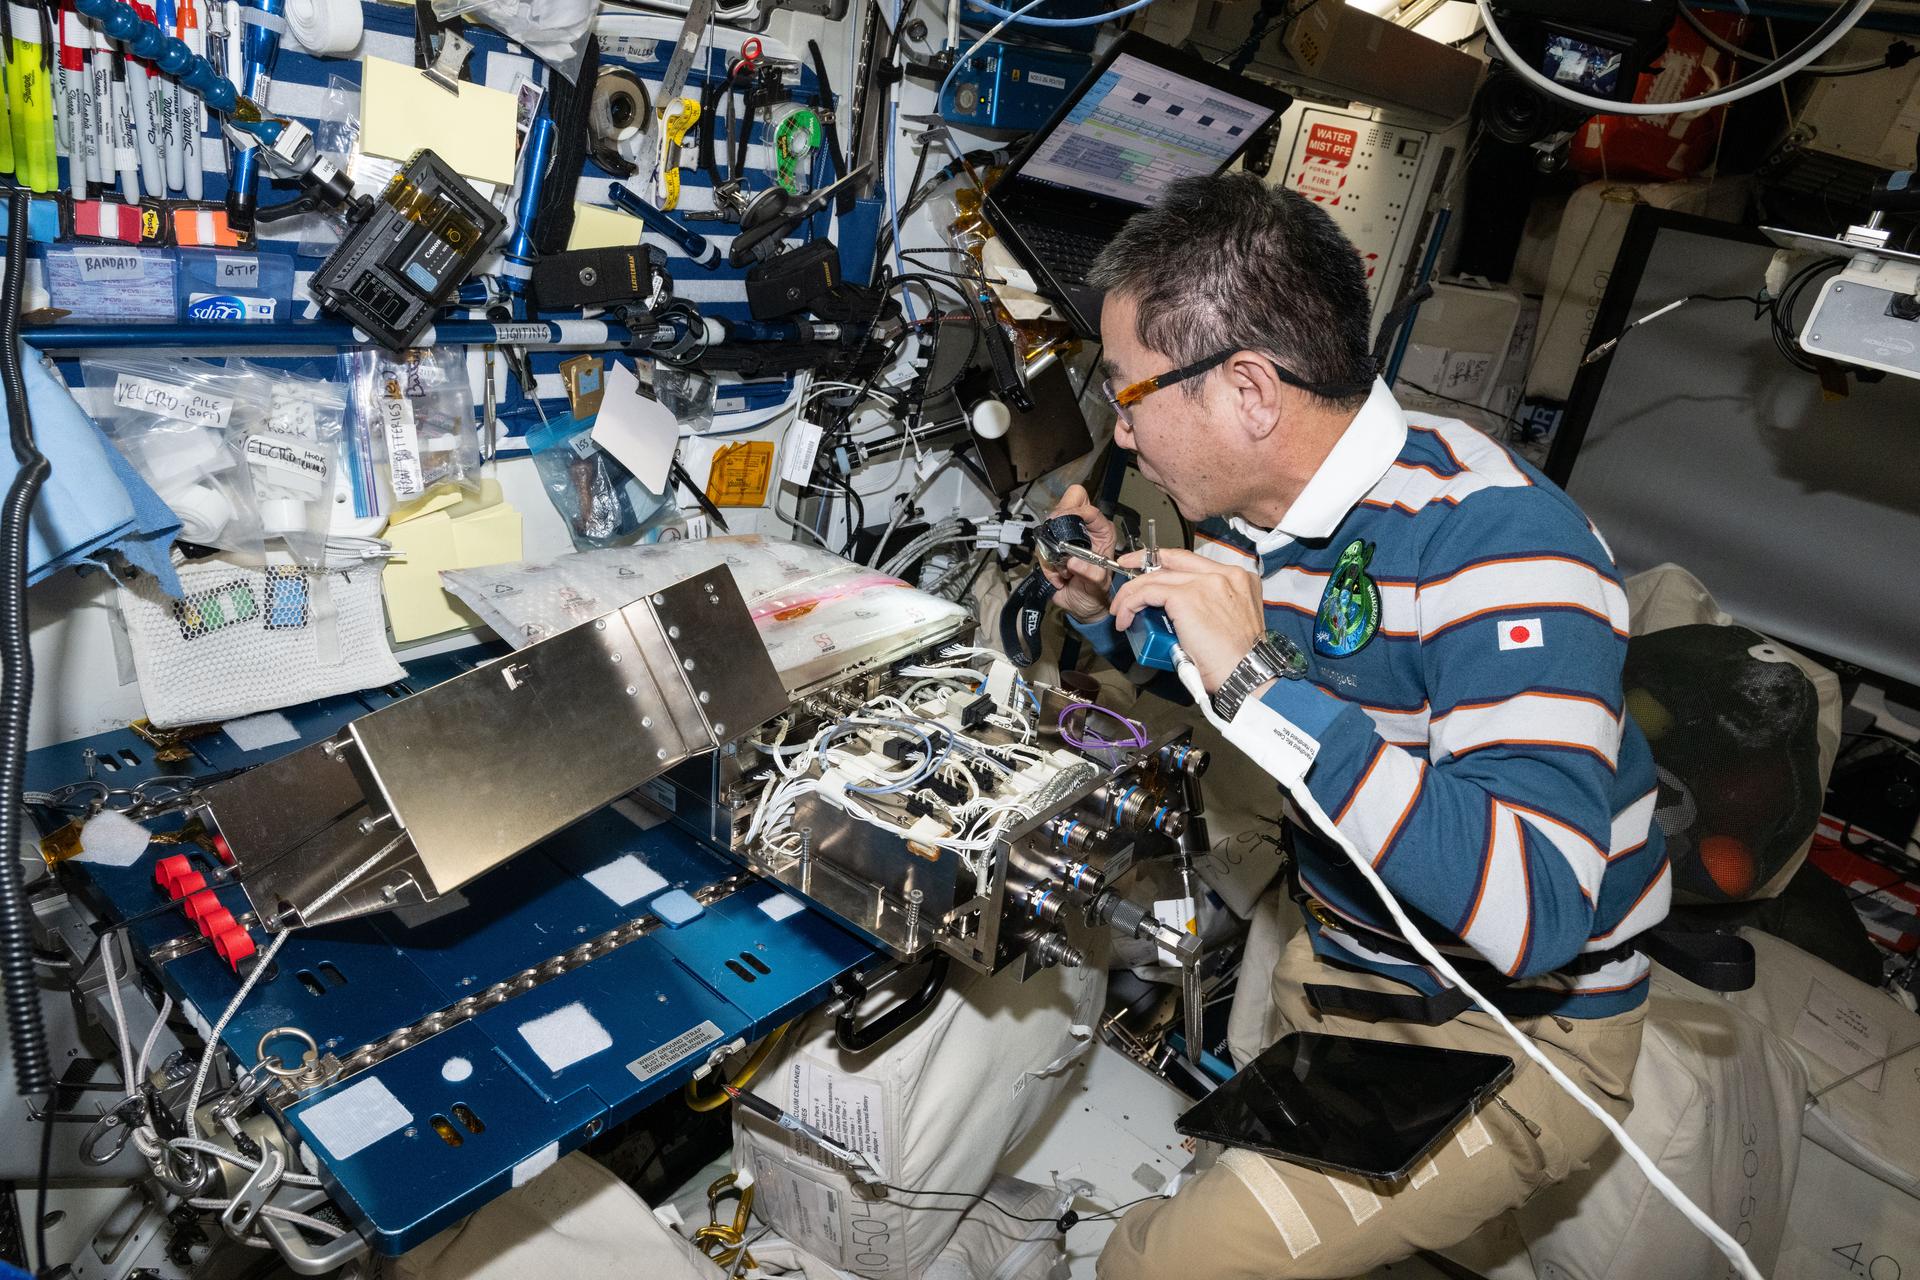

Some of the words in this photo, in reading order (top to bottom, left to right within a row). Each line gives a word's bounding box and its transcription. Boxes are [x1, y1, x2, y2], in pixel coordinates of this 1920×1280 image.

[1316, 128, 1352, 144] WATER
[1309, 139, 1332, 154] MIST
[1333, 143, 1352, 157] PFE
[1308, 165, 1340, 178] PORTABLE
[1311, 176, 1332, 187] FIRE
[425, 239, 442, 259] Canon
[85, 257, 138, 272] BANDAID
[224, 264, 257, 277] QTIP
[628, 254, 638, 292] LEATHERMAN
[498, 324, 549, 341] LIGHTING
[119, 383, 178, 411] VELCRO
[192, 396, 221, 410] PILE
[574, 438, 590, 452] ISS
[394, 469, 417, 496] NEW
[1366, 584, 1378, 627] EXPEDITION
[1023, 607, 1041, 644] PETZL
[1271, 727, 1287, 741] Cable
[1281, 726, 1292, 737] Mic
[1284, 737, 1295, 747] Mic
[1289, 732, 1312, 751] Handheld
[1291, 742, 1314, 761] Handheld
[1308, 748, 1316, 756] To
[637, 1052, 658, 1067] WRIST
[657, 1037, 684, 1055] GROUND
[682, 1027, 703, 1041] STRAP
[641, 1057, 660, 1071] MUST
[659, 1052, 670, 1060] BE
[669, 1042, 687, 1055] WORN
[686, 1032, 706, 1045] WHEN
[646, 1060, 667, 1074] USING
[666, 1053, 681, 1063] THIS
[679, 1033, 714, 1056] HARDWARE
[793, 1064, 802, 1097] CLEANER
[863, 1095, 871, 1112] Battery
[872, 1137, 880, 1154] Adapter
